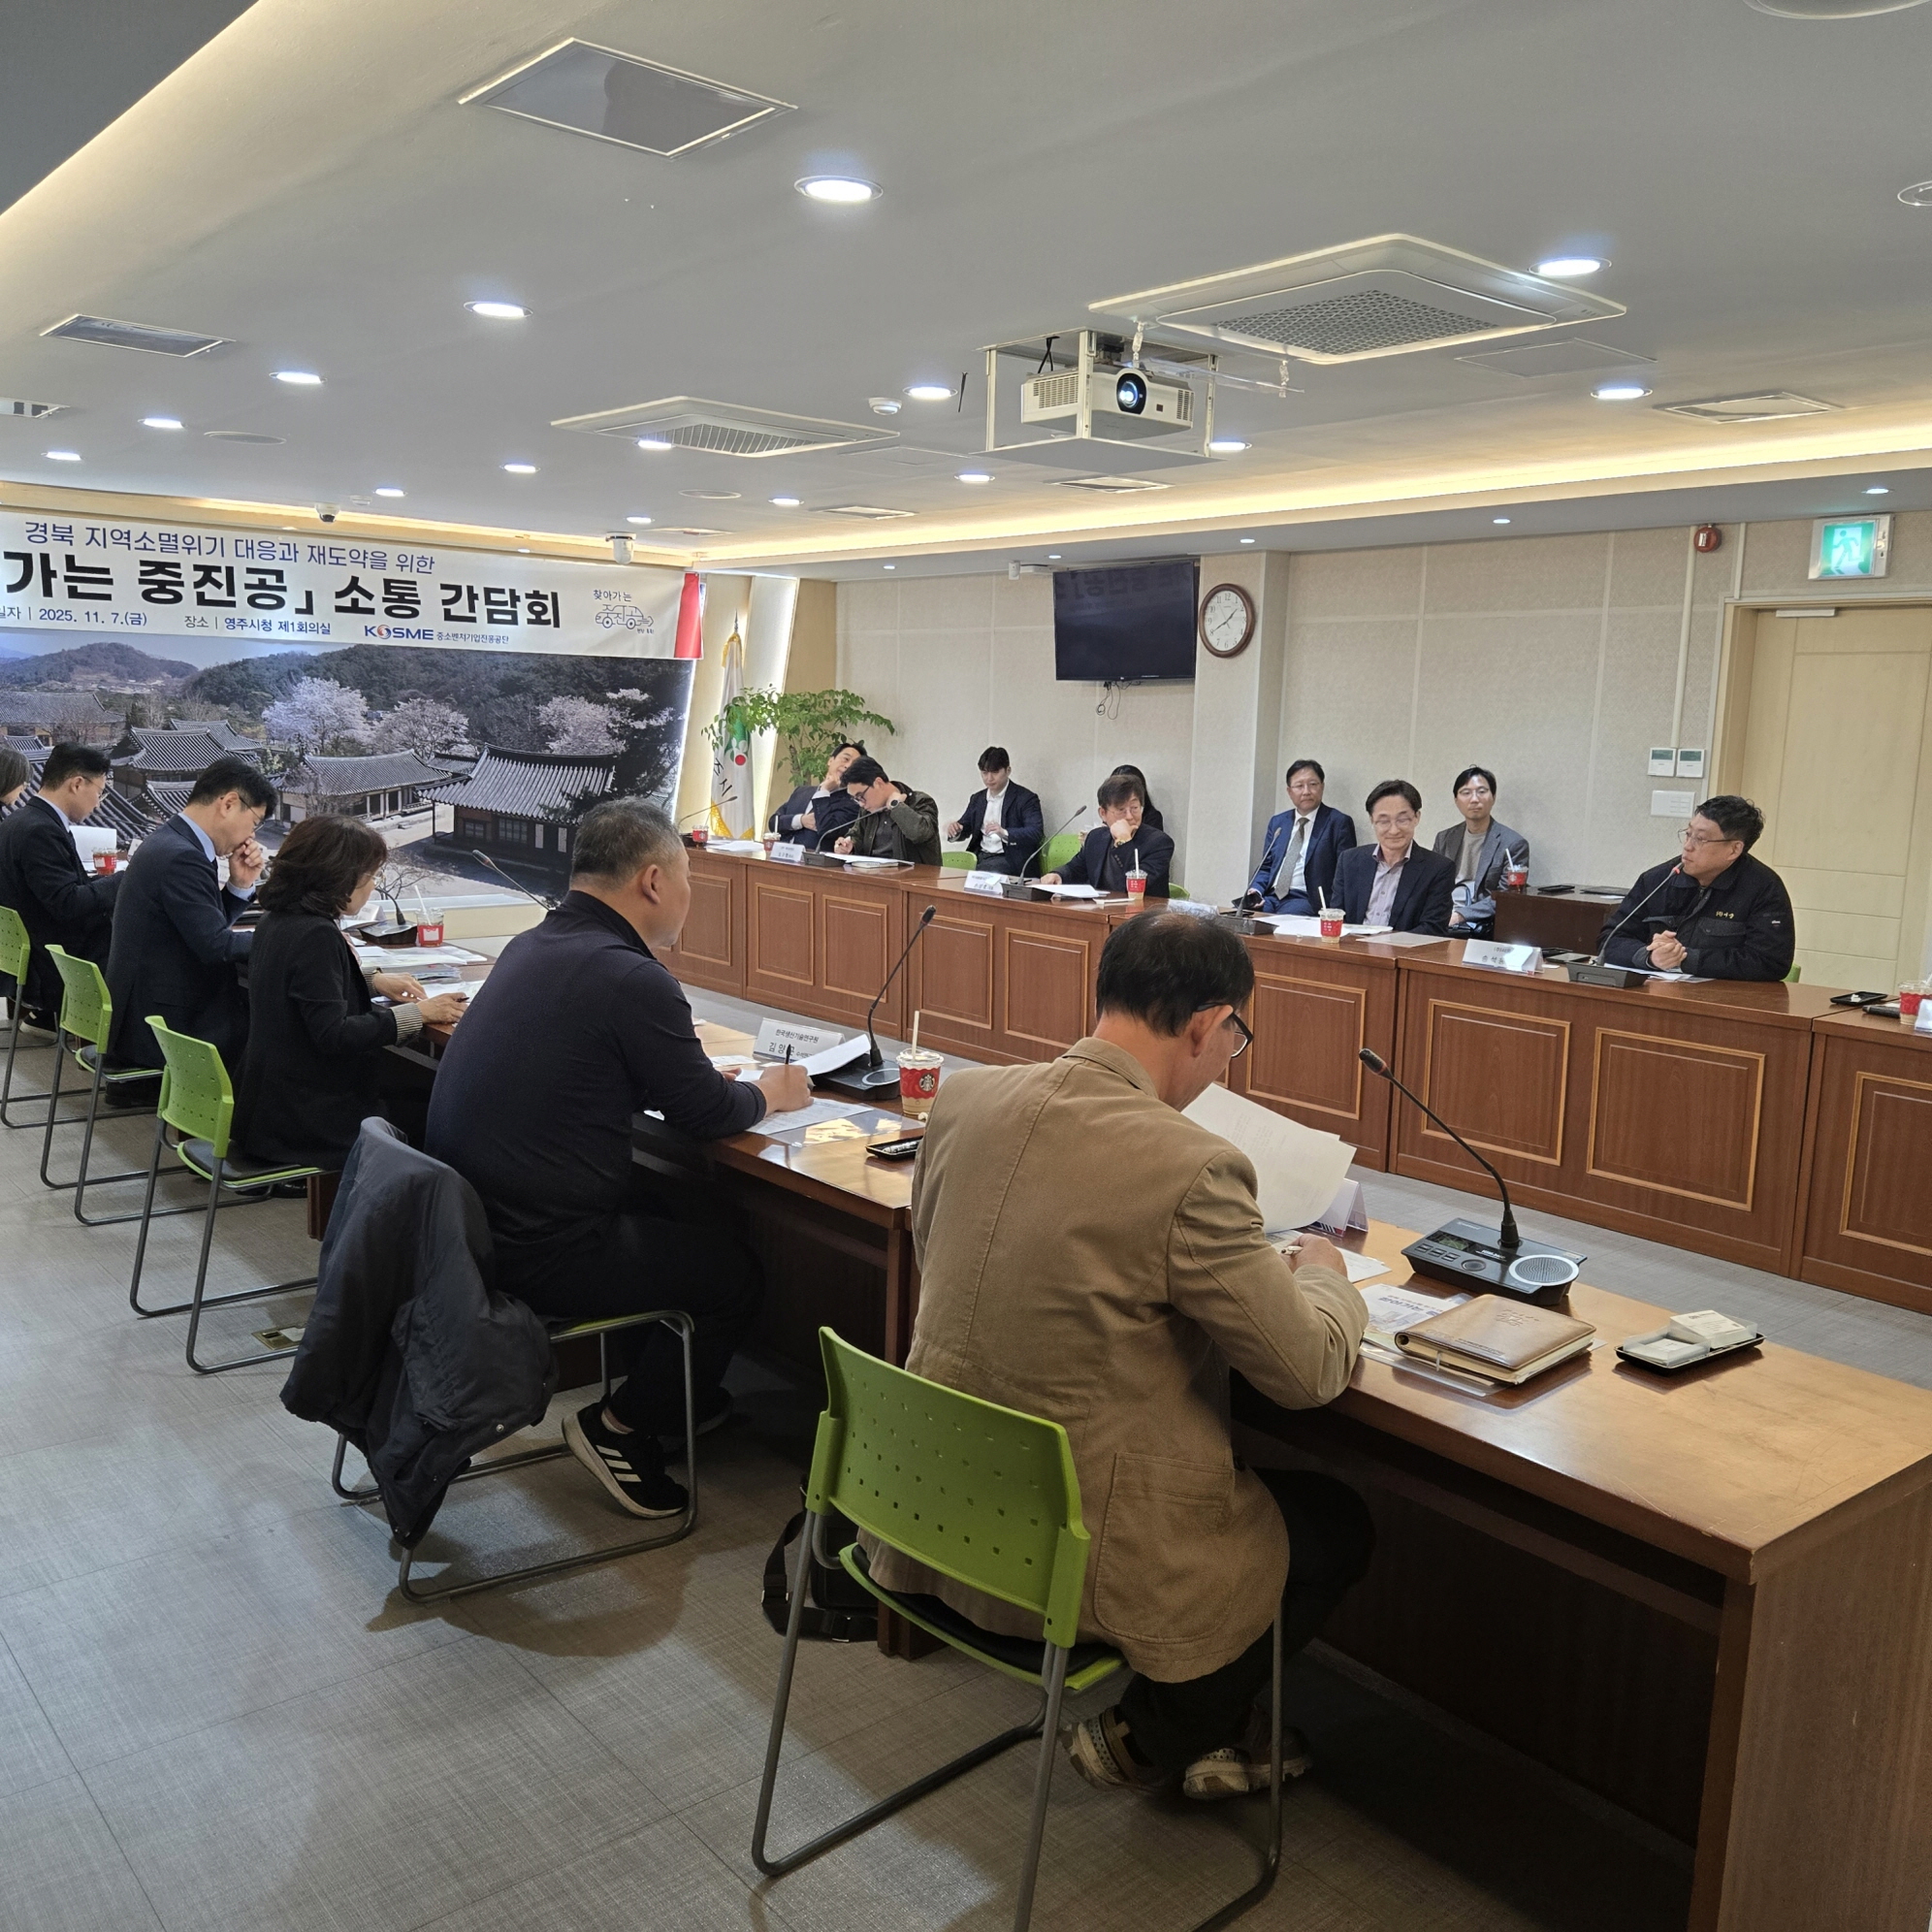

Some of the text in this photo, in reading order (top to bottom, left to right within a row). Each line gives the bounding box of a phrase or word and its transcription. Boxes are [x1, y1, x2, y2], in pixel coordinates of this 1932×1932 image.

[25, 521, 435, 575] 경북 지역소멸위기 대응과 재도약을 위한
[3, 551, 114, 602] 가는
[335, 575, 421, 619] 소통
[439, 583, 561, 628] 간담회
[593, 589, 632, 602] 찾아가는
[39, 608, 78, 623] 2025.
[84, 611, 105, 624] 11.
[111, 612, 147, 627] 7.(금)
[184, 616, 331, 635] 장소 영주시청 제1회의실
[365, 624, 435, 641] KOSME
[436, 631, 510, 645] 중소벤처기업진흥공단
[775, 1028, 820, 1045] 한국생산기술연구원
